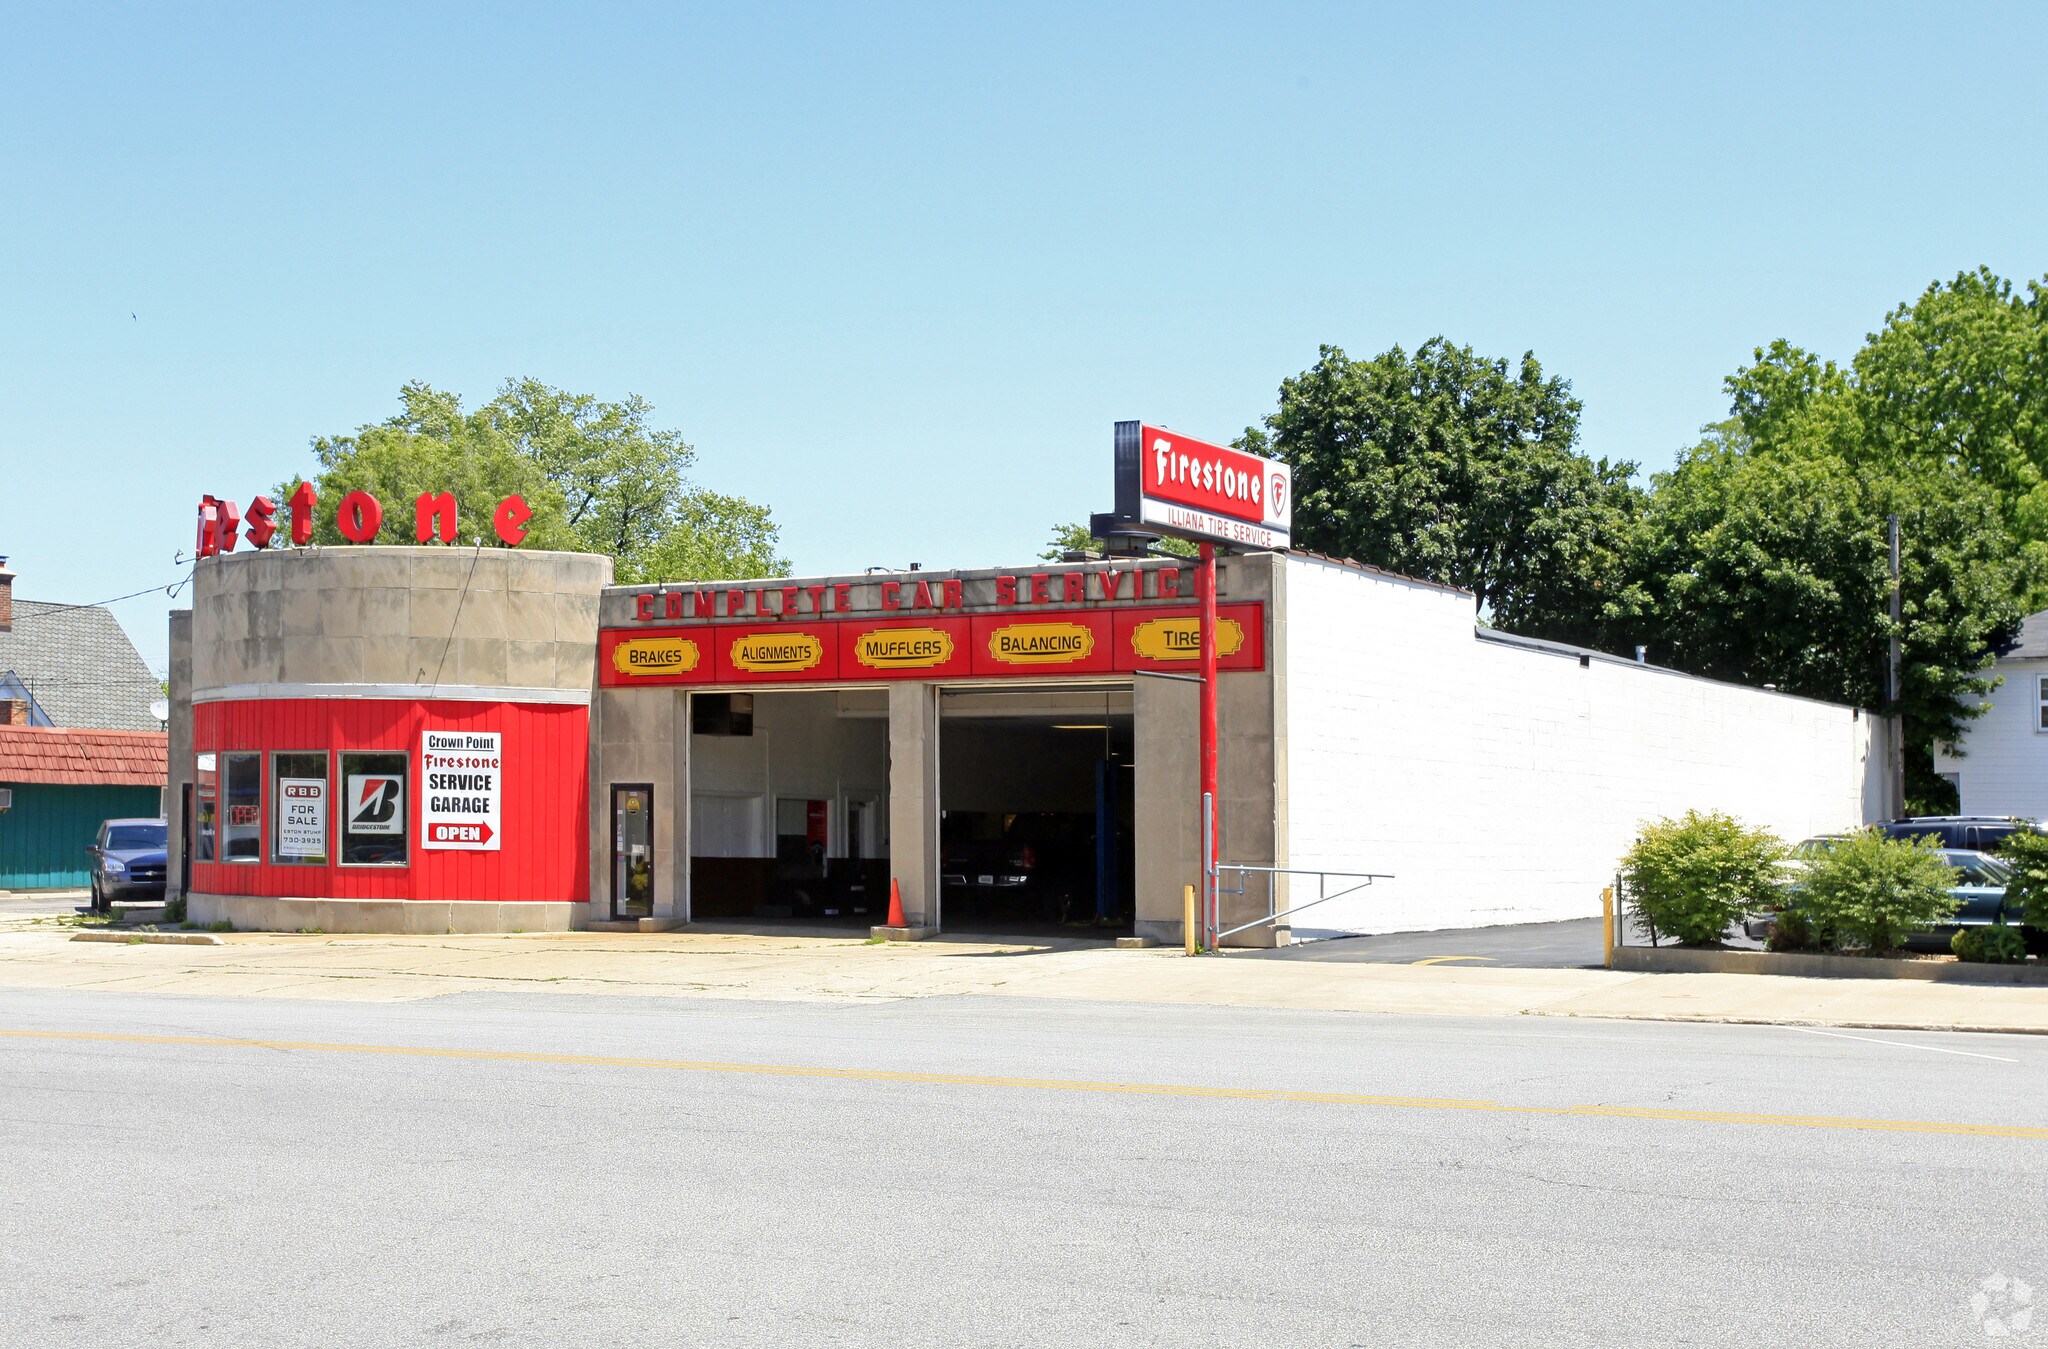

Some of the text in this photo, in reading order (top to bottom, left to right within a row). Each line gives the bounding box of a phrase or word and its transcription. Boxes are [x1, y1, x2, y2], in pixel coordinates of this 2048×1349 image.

[1153, 438, 1261, 505] Firestone
[1168, 508, 1272, 547] ILLIANA TIRE SERVICE
[637, 567, 1200, 622] COMPLETE CAR SERVIC
[1000, 635, 1082, 652] BALANCING
[1163, 630, 1200, 647] TIRE
[629, 649, 682, 664] BRAKES
[741, 645, 812, 660] ALIGNMENTS
[866, 640, 942, 657] MUFFLERS
[429, 735, 494, 750] Crown Point
[424, 754, 499, 770] Firestone
[429, 773, 492, 791] SERVICE
[287, 787, 318, 796] RBB
[291, 805, 315, 814] FOR
[430, 796, 490, 814] GARAGE
[231, 806, 259, 825] OPEN
[287, 816, 318, 826] SALE
[435, 826, 480, 841] OPEN
